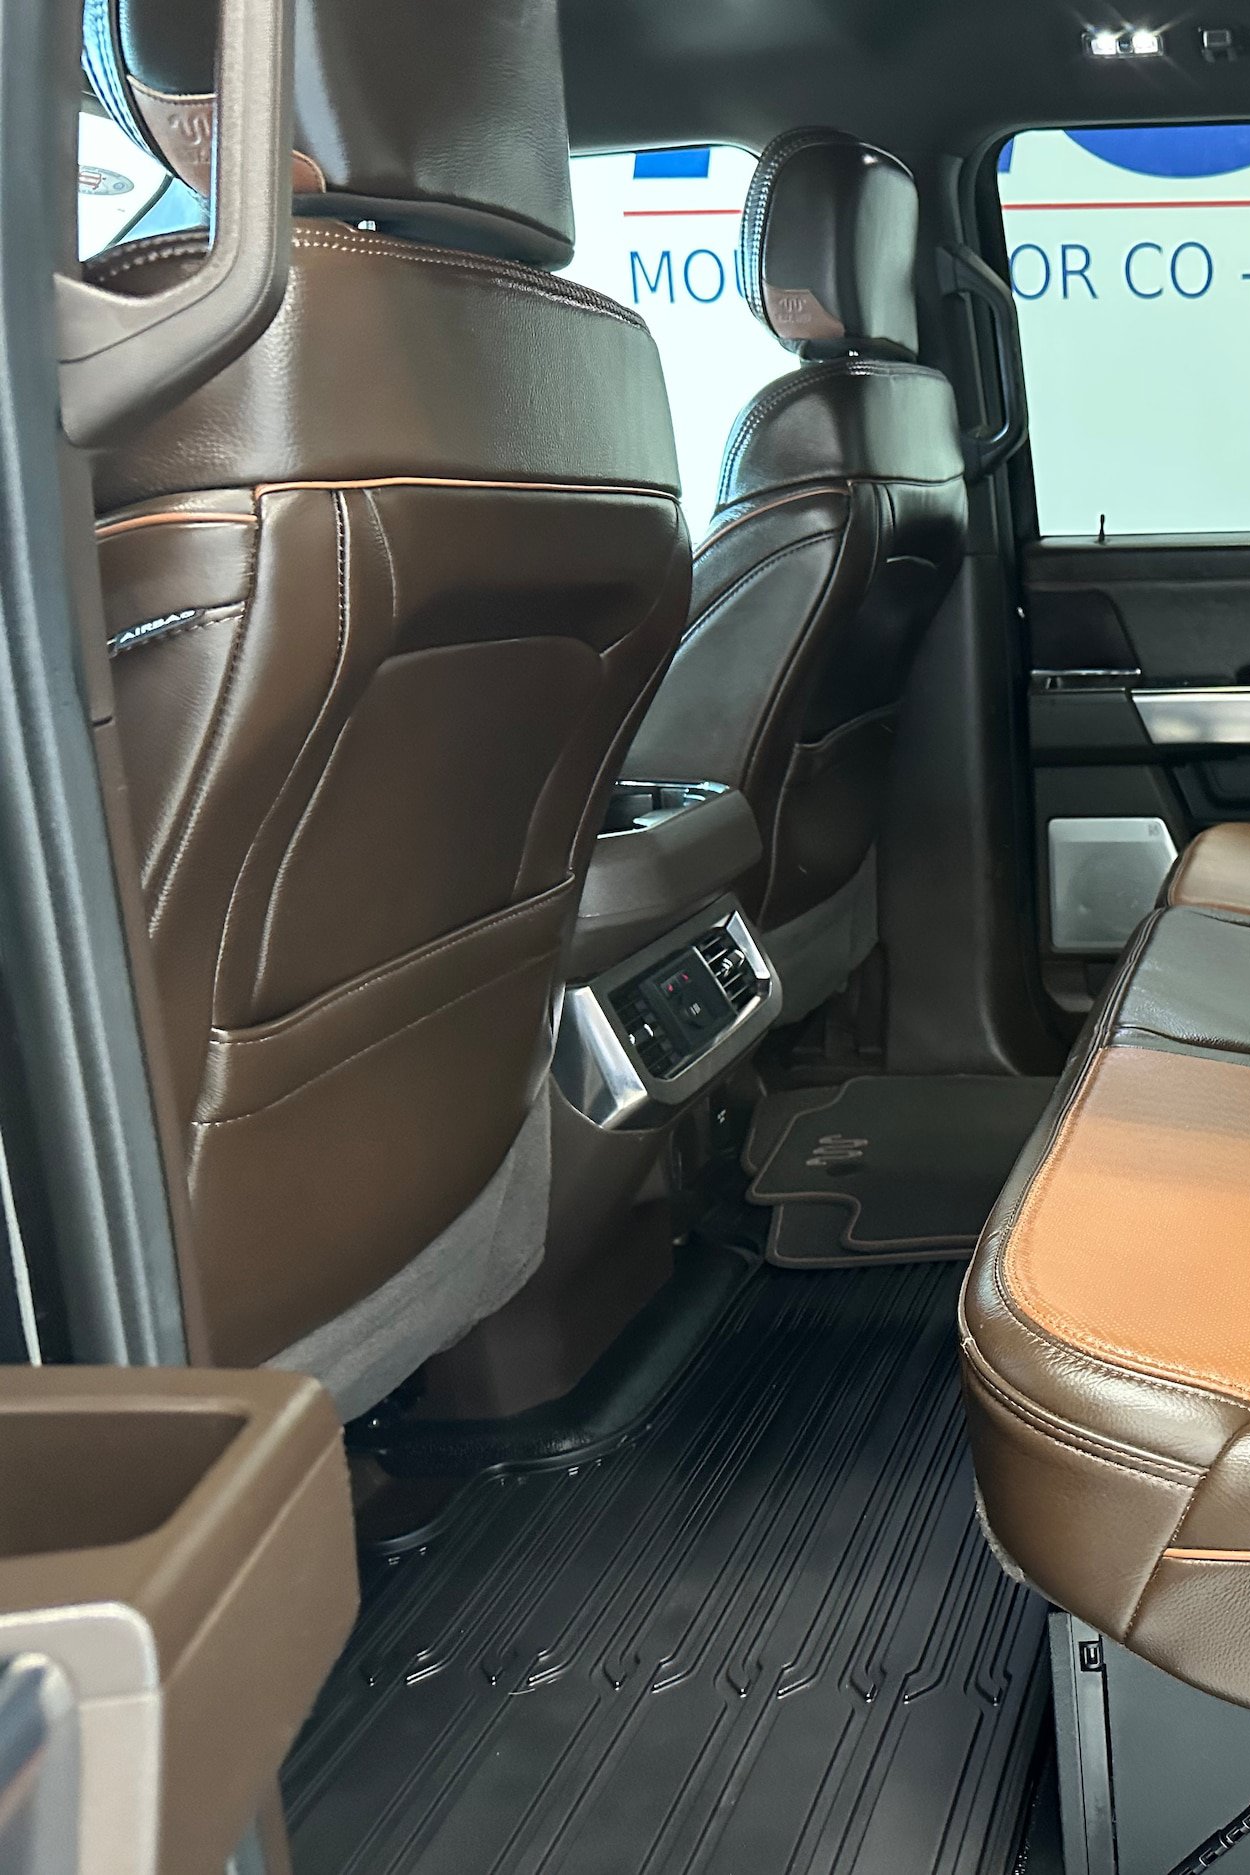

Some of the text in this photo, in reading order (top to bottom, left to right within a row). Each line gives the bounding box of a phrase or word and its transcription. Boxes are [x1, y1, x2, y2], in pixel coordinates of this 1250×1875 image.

[628, 249, 744, 303] MO
[1009, 244, 1098, 300] OR
[1125, 242, 1213, 299] CO
[120, 610, 196, 643] AIRBAG
